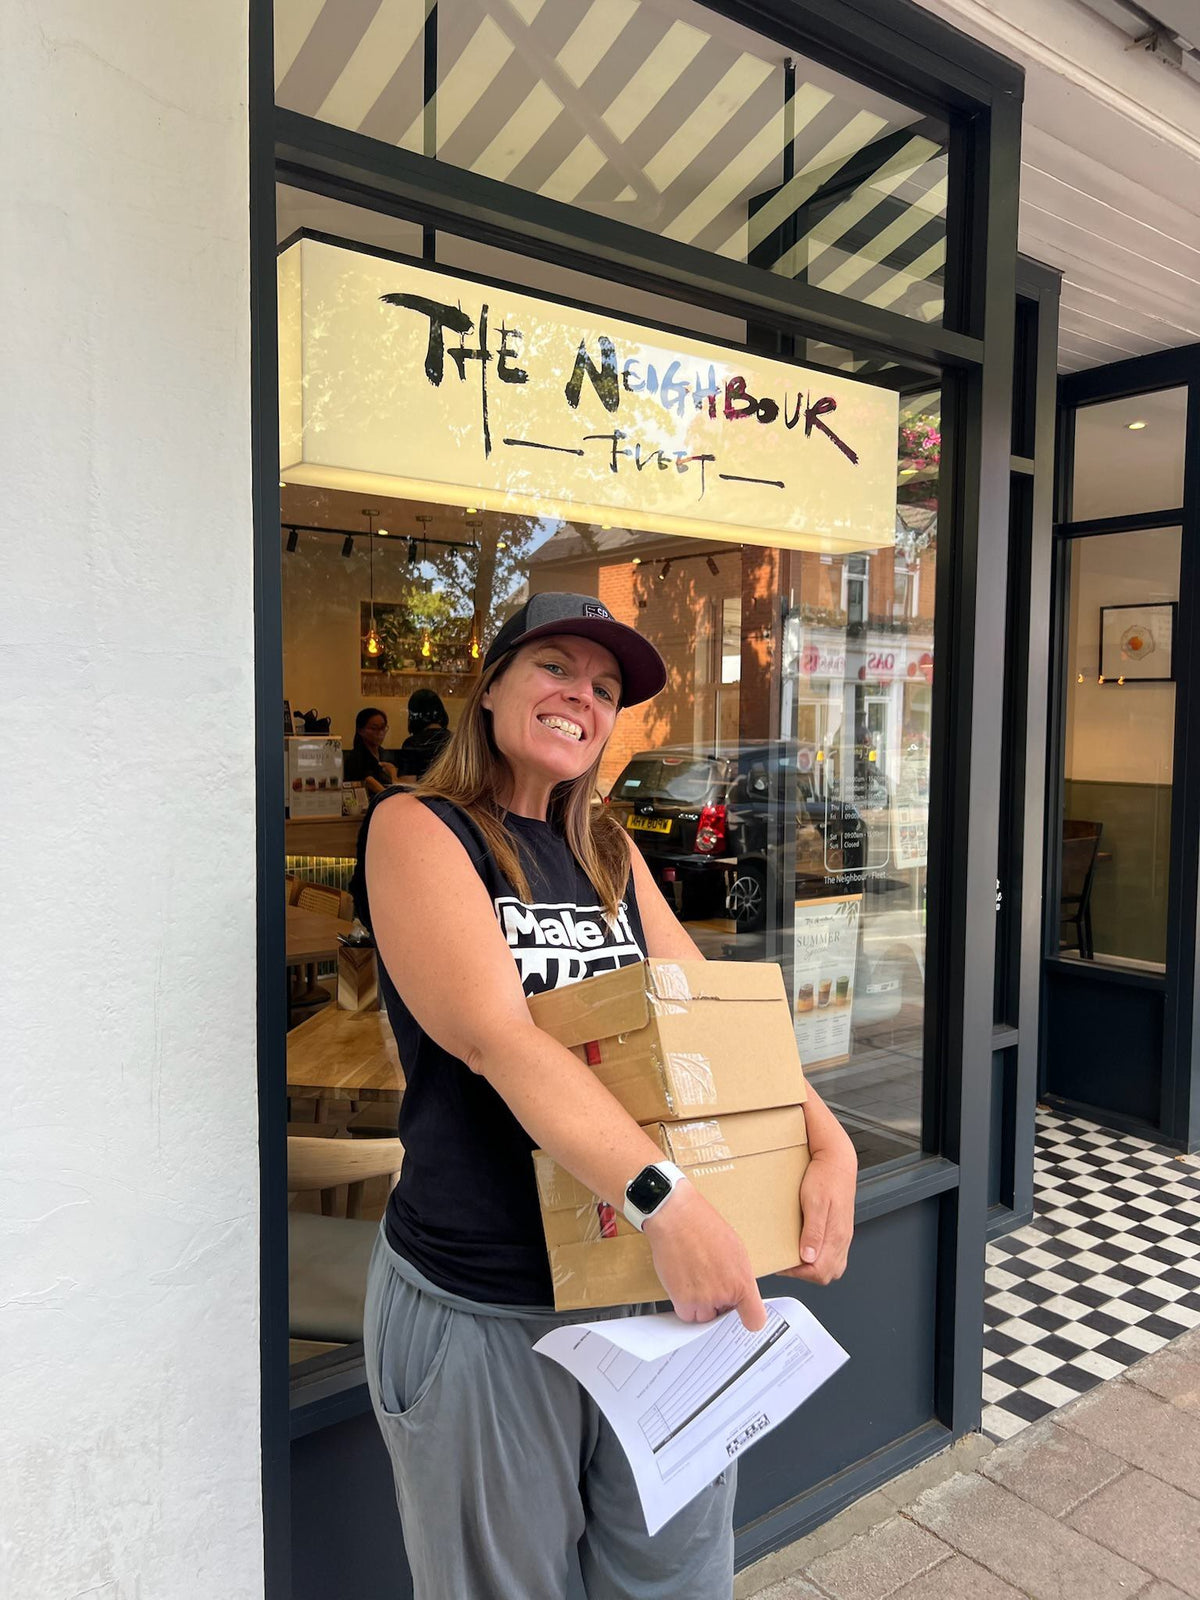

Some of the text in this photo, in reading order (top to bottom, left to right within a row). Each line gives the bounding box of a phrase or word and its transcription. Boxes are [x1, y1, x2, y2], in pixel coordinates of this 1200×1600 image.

[379, 292, 529, 460] THE
[583, 429, 716, 501] FLEET
[829, 833, 838, 841] Sat
[829, 840, 860, 850] Sun Closed
[824, 876, 836, 885] The
[796, 931, 841, 948] SUMMER
